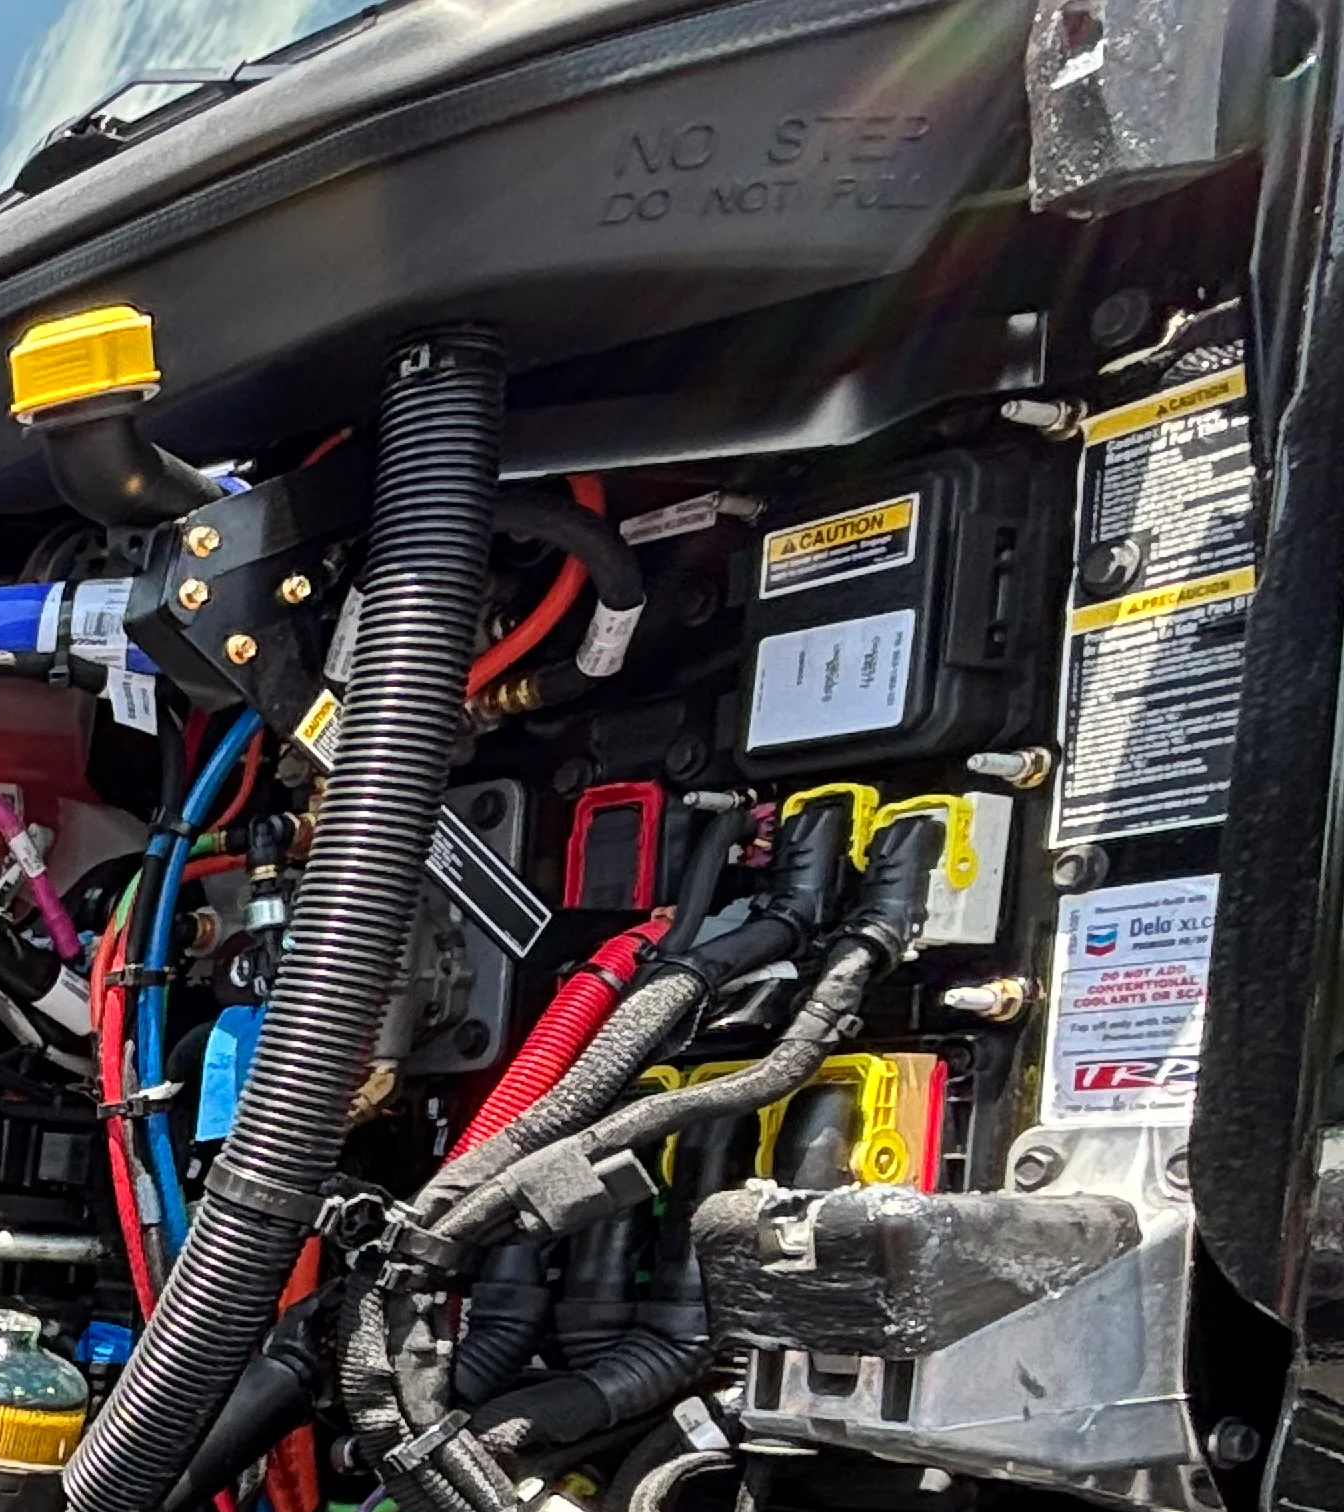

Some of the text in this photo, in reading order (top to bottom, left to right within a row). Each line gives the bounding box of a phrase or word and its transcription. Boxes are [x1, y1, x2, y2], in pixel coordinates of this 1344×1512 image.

[615, 115, 930, 177] NO STEP
[600, 190, 670, 226] DO
[708, 179, 798, 215] NOT
[798, 513, 885, 550] CAUTION
[1129, 915, 1172, 938] Delo
[1086, 975, 1200, 995] CONVENTIONAL
[1100, 965, 1187, 982] DO NOT ADD
